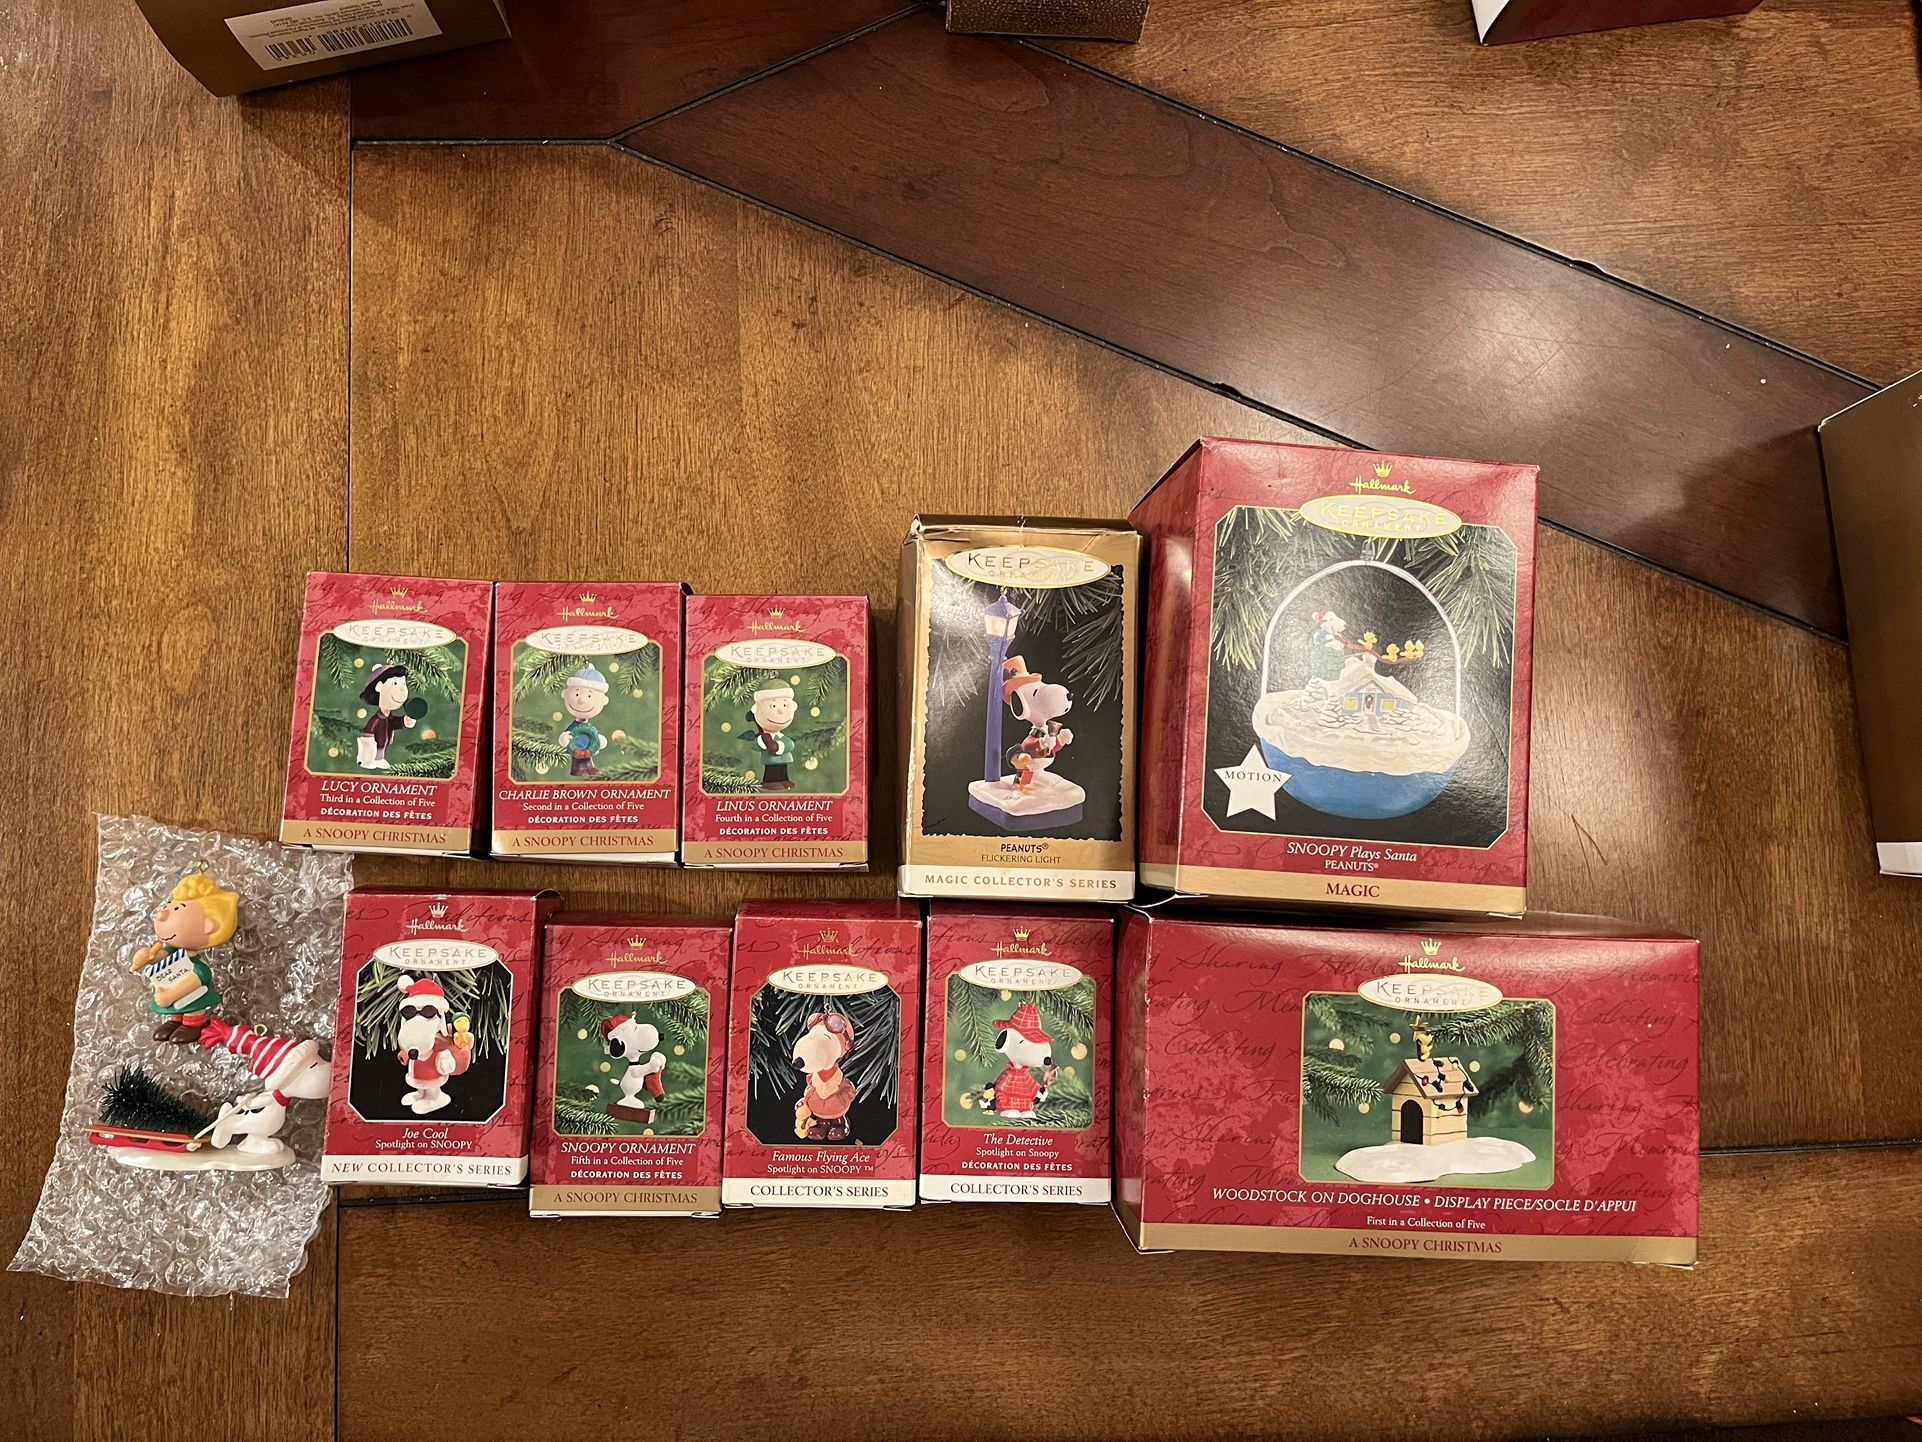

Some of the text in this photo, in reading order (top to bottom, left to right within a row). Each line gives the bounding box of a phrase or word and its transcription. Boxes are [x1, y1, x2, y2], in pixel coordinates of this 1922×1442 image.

[1348, 475, 1416, 494] Hallmark
[1319, 502, 1447, 525] KEEPSAKE
[1342, 519, 1422, 532] ORNAMENT
[968, 552, 1095, 572] KEEPSAKE
[368, 599, 428, 615] Hallmark
[557, 605, 620, 622] Hallmark
[349, 624, 444, 639] KEEPSAKE
[747, 621, 807, 636] Hallmark
[541, 632, 637, 644] KEEPSAKE
[731, 646, 825, 658] KEEPSAKE
[1225, 770, 1282, 782] MOTION
[321, 780, 438, 796] LUCY ORNAMENT
[499, 789, 672, 800] CHARLIE BROWN ORNAMENT
[320, 793, 344, 803] Third
[345, 795, 354, 803] in
[363, 796, 405, 805] Collection
[407, 797, 417, 806] of
[418, 798, 436, 807] Five
[523, 802, 552, 811] Second
[554, 802, 563, 811] in
[571, 801, 614, 811] Collection
[616, 801, 626, 810] of
[627, 801, 645, 810] Five
[716, 800, 834, 812] LINUS ORNAMENT
[320, 807, 433, 820] DÉCORATION DES FÊTES
[528, 814, 586, 824] DÉCORATION
[610, 814, 639, 823] FÊTES
[715, 814, 743, 823] Fourth
[744, 814, 753, 822] in
[761, 814, 803, 822] Collection
[805, 814, 814, 822] of
[816, 814, 833, 822] Five
[303, 828, 447, 844] A SNOOPY CHRISTMAS
[719, 826, 777, 835] DÉCORATION
[801, 826, 828, 835] FÊTES
[512, 835, 654, 847] A SNOOPY CHRISTMAS
[704, 847, 844, 858] A SNOOPY CHRISTMAS
[1287, 841, 1417, 862] SNOOPY Plays Santa
[981, 854, 1062, 864] FLICKERING LIGHT
[925, 875, 1117, 889] MAGIC COLLECTOR'S SERIES
[1326, 883, 1380, 898] MAGIC
[405, 918, 469, 936] Hallmark
[389, 947, 487, 959] KEEPSAKE
[797, 943, 858, 959] Hallmark
[991, 942, 1052, 958] Hallmark
[605, 951, 668, 969] Hallmark
[1398, 955, 1465, 974] Hallmark
[156, 969, 172, 982] DEAR
[168, 968, 188, 982] SANTA
[783, 971, 878, 983] KEEPSAKE
[975, 965, 1072, 979] KEEPSAKE
[588, 978, 686, 992] KEEPSAKE
[990, 978, 1052, 986] ORNAMENT
[1376, 981, 1489, 998] KEEPSAKE
[1395, 996, 1465, 1006] ORNAMENT
[402, 1128, 448, 1139] Joe Cool
[984, 1133, 1054, 1146] The Detective
[375, 1139, 415, 1150] Spotlight
[430, 1140, 473, 1149] SNOOPY
[561, 1142, 697, 1155] SNOOPY ORNAMENT
[771, 1150, 871, 1165] Famous Flying Ace
[976, 1147, 1013, 1158] Spotlight
[1028, 1148, 1059, 1159] Snoopy
[571, 1156, 591, 1165] Fifth
[592, 1157, 601, 1165] in
[610, 1156, 653, 1166] Collection
[655, 1156, 664, 1166] of
[666, 1157, 684, 1166] Five
[962, 1160, 1020, 1170] DÉCORATION
[1044, 1161, 1073, 1171] FÊTES
[331, 1162, 512, 1176] NEW COLLECTOR'S SERIES
[570, 1169, 683, 1179] DÉCORATION DES FÊTES
[767, 1164, 805, 1175] Spotlight
[820, 1165, 862, 1174] SNOOPY
[750, 1185, 889, 1197] COLLECTOR'S SERIES
[950, 1183, 1083, 1196] COLLECTOR'S SERIES
[553, 1192, 698, 1204] A SNOOPY CHRISTMAS
[1212, 1188, 1636, 1212] WOODSTOCK ON DOGHOUSE DISPLAY PIECE/SOCLE D'APPUI
[1367, 1216, 1386, 1226] First
[1389, 1217, 1398, 1226] in
[1407, 1217, 1453, 1228] Collection
[1455, 1218, 1465, 1229] of
[1467, 1219, 1486, 1229] Five
[1348, 1237, 1502, 1254] A SNOOPY CHRISTMAS
